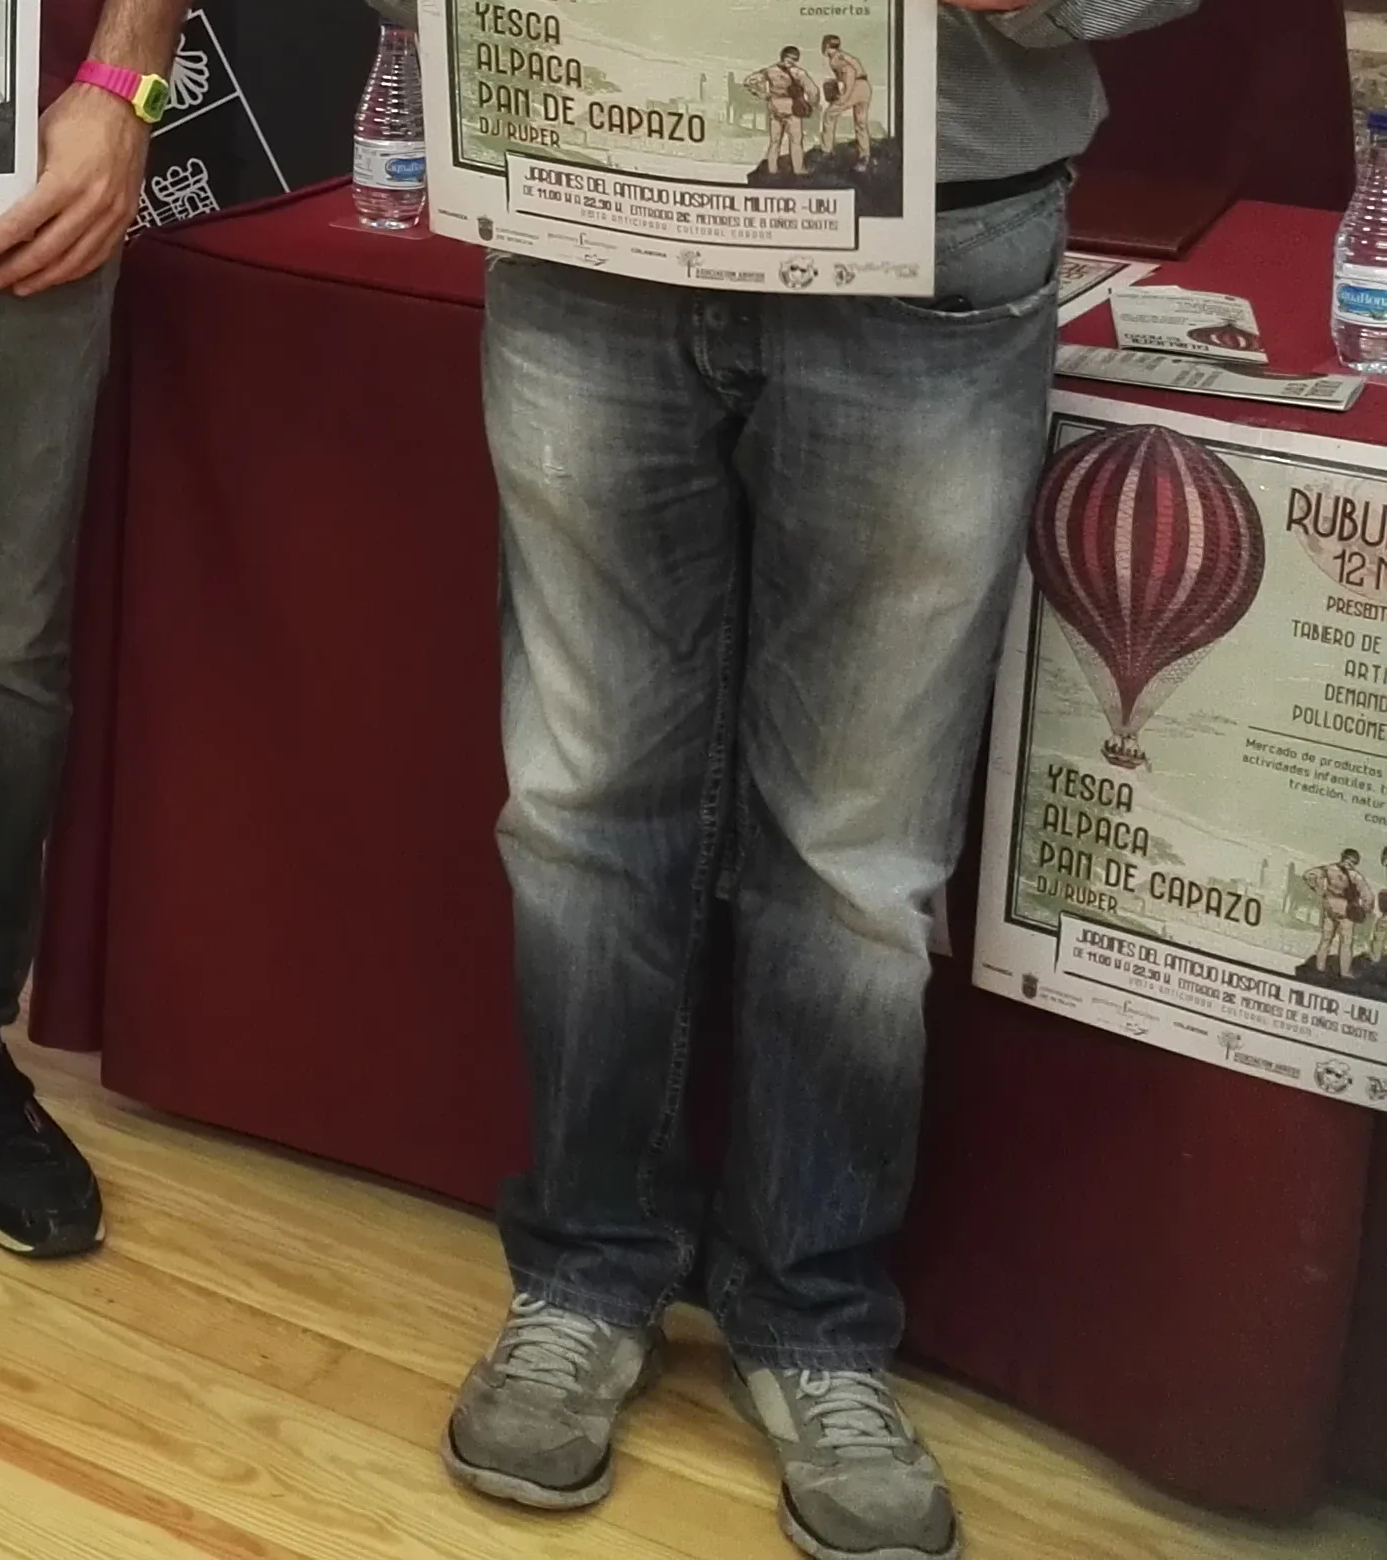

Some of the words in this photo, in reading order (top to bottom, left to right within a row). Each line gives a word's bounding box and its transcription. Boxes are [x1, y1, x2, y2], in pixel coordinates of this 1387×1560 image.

[475, 2, 561, 45] YESCA
[476, 42, 582, 88] ALPACA
[478, 81, 530, 117] PAN
[543, 93, 575, 125] DE
[588, 101, 706, 144] CAPAZO
[479, 117, 500, 137] DJ
[507, 122, 560, 148] RUPER
[1284, 486, 1387, 549] RUBU
[1331, 547, 1367, 587] 12
[1361, 633, 1387, 653] DE
[1046, 764, 1134, 813] YESCA
[1042, 803, 1150, 857] ALPACA
[1036, 876, 1058, 897] DJ
[1064, 883, 1118, 914] RUPER
[1039, 841, 1093, 881] PAN
[1104, 857, 1138, 893] DE
[1149, 870, 1263, 928] CAPAZO
